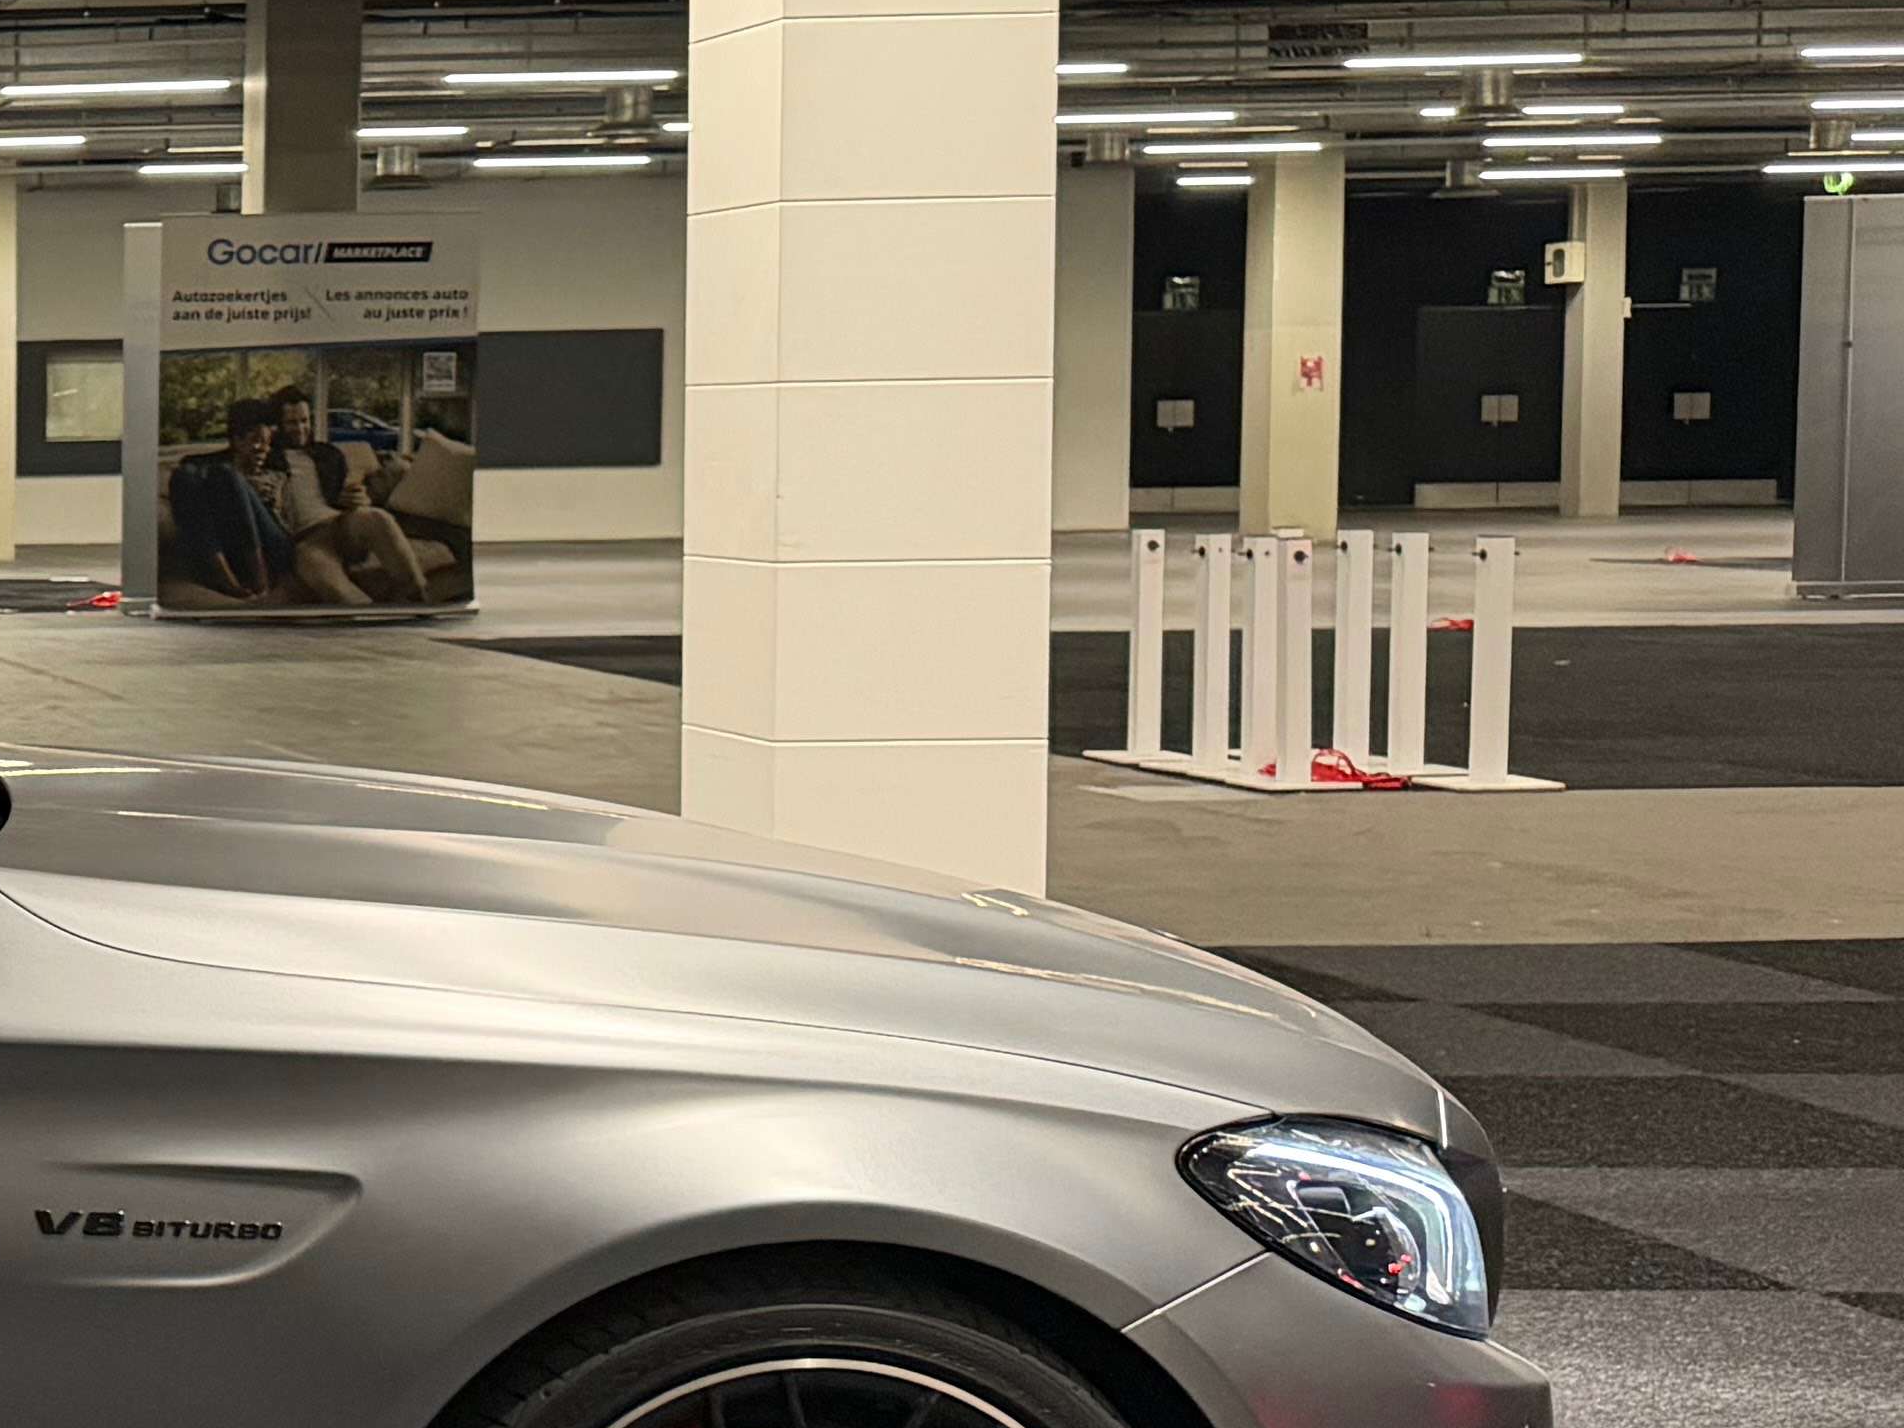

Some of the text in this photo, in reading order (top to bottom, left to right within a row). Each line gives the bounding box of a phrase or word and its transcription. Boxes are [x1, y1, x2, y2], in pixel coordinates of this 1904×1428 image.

[332, 246, 424, 258] MARKETPLACE
[172, 289, 288, 304] Autozoekertjes
[326, 289, 469, 302] Les annonces auto
[172, 307, 311, 323] aan de juiste prijs!
[363, 308, 382, 320] au
[385, 307, 424, 322] juste
[428, 307, 461, 322] prix
[34, 1209, 283, 1241] V8 BITURBO
